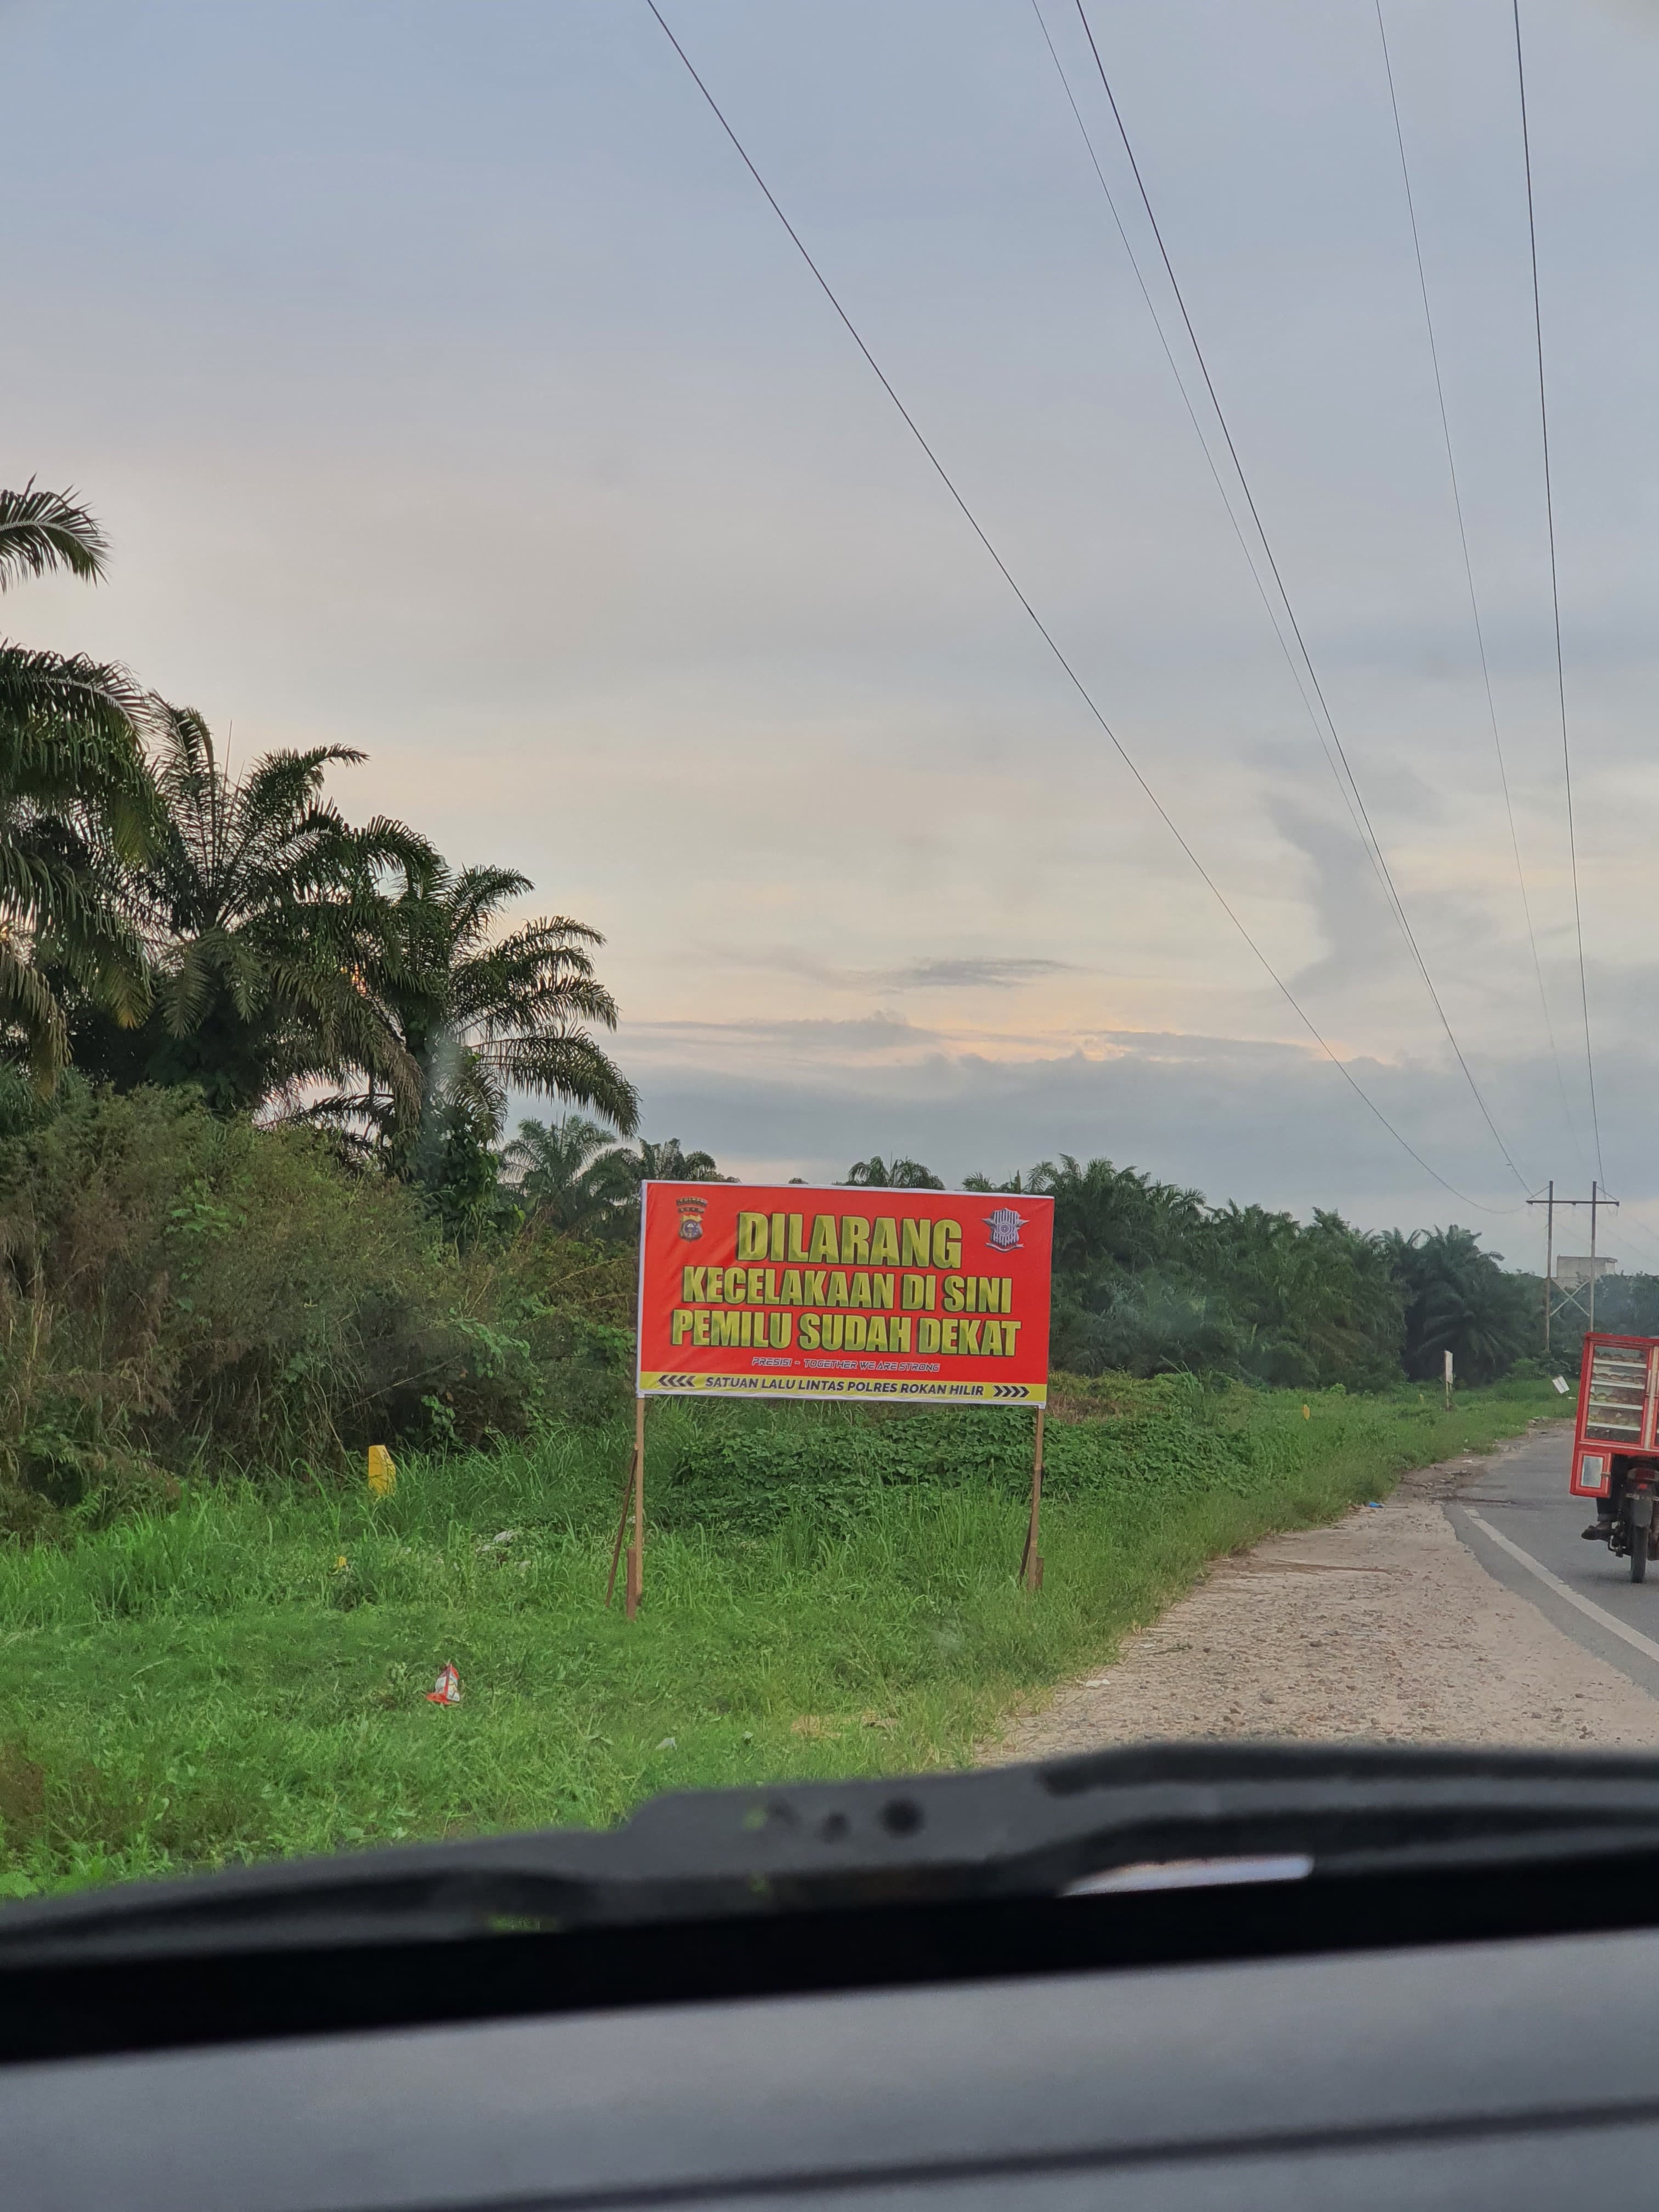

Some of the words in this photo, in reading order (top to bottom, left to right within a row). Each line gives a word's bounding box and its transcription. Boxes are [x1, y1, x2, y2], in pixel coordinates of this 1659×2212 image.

[738, 1212, 962, 1268] DILARANG
[683, 1266, 894, 1310] KECELAKAAN
[902, 1274, 934, 1310] DI
[943, 1275, 1012, 1313] SINI
[671, 1310, 792, 1349] PEMILU
[799, 1313, 911, 1353] SUDAH
[918, 1319, 1022, 1356] DEKAT
[705, 1376, 759, 1389] SATUAN
[761, 1378, 796, 1390] LALU
[798, 1379, 845, 1391] LINTAS
[847, 1381, 898, 1393] POLRES
[900, 1383, 947, 1395] ROKAN
[949, 1384, 984, 1397] HILIR
[752, 1357, 792, 1367] PRESISI
[804, 1358, 857, 1369] TOGETHER
[860, 1361, 876, 1370] WE
[877, 1361, 898, 1371] ARE
[899, 1363, 940, 1372] STRONG
